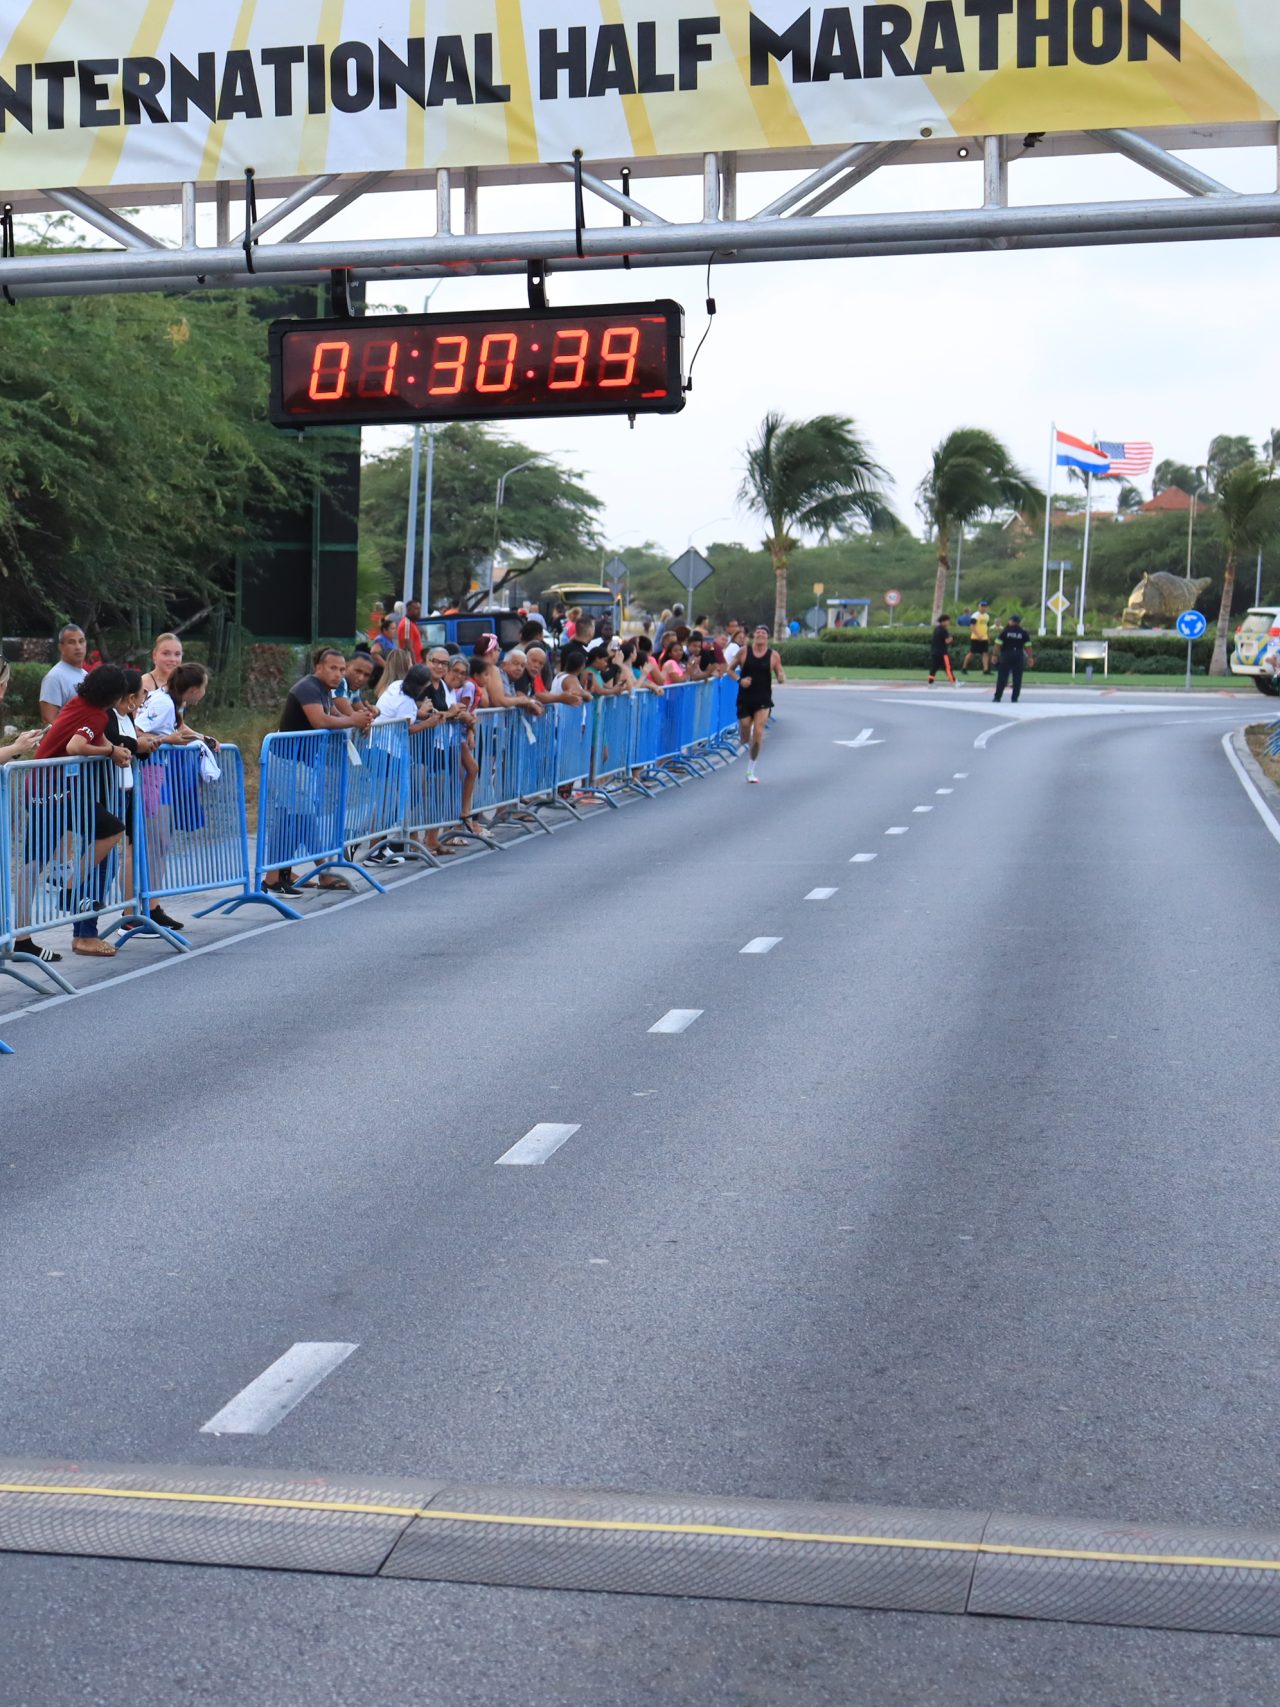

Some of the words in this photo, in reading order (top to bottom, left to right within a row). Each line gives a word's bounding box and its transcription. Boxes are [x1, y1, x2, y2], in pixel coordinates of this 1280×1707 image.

[539, 17, 720, 99] HALF
[749, 0, 1181, 86] MARATHON
[309, 327, 640, 401] 01:30:39
